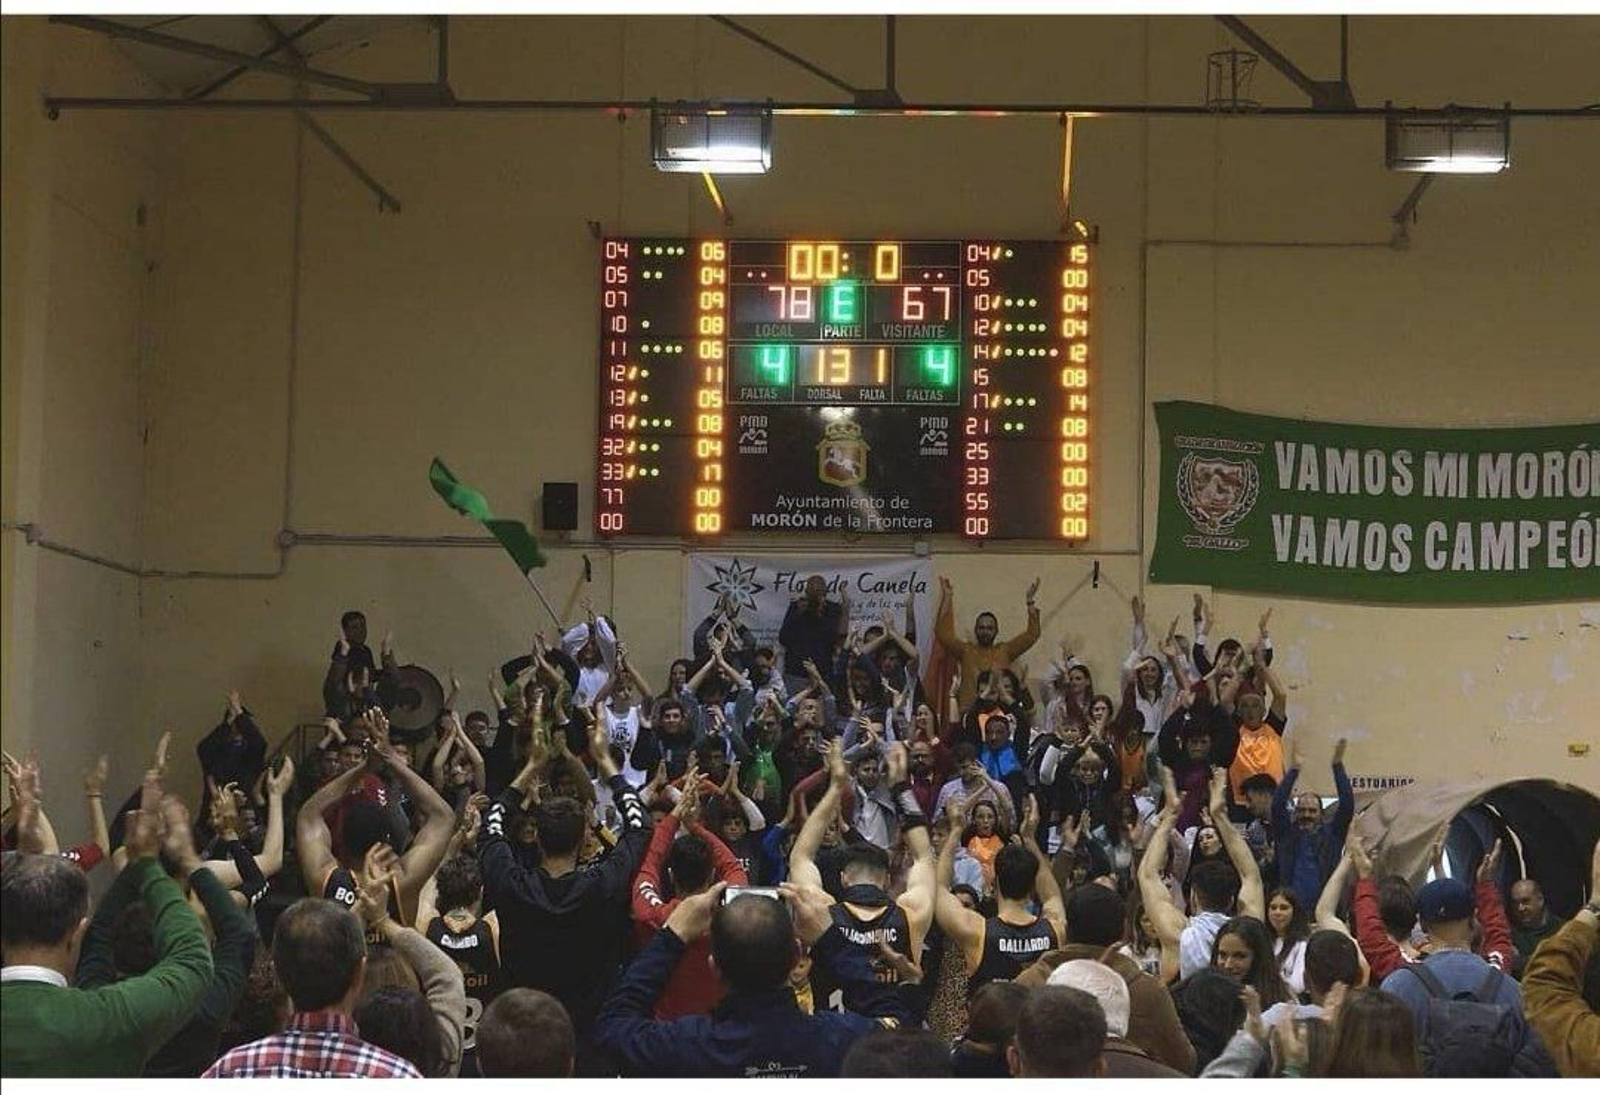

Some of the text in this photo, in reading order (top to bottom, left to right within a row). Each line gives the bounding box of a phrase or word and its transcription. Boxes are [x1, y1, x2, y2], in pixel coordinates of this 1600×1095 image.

[606, 242, 628, 259] 04
[876, 245, 898, 280] 0
[967, 245, 990, 262] 04
[606, 267, 627, 284] 05
[701, 267, 724, 284] 04
[967, 269, 990, 287] 05
[605, 291, 627, 308] 07
[700, 291, 724, 309] 09
[768, 287, 811, 320] 78
[832, 286, 853, 320] E
[903, 287, 950, 320] 67
[975, 294, 990, 311] 10
[612, 316, 627, 333] 10
[700, 316, 723, 334] 08
[755, 325, 794, 337] LOCAL
[824, 325, 861, 337] PARTE
[882, 325, 945, 337] VISITANTE
[974, 319, 989, 335] 12
[611, 341, 626, 356] 11
[974, 345, 989, 359] 14
[610, 365, 625, 382] 12
[763, 347, 785, 383] 4
[818, 349, 850, 383] 13
[926, 348, 949, 384] 4
[706, 366, 723, 382] 11
[974, 369, 989, 386] 15
[610, 390, 625, 406] 13
[699, 390, 722, 407] 05
[741, 388, 777, 399] FALTAS
[808, 389, 841, 399] DORSAL
[860, 389, 885, 400] FALTA
[907, 390, 943, 400] FALTAS
[974, 394, 988, 409] 17
[610, 415, 624, 430] 19
[698, 414, 722, 432] 08
[966, 417, 988, 434] 21
[603, 439, 624, 456] 32
[698, 439, 722, 457] 04
[966, 443, 988, 460] 25
[603, 464, 623, 480] 33
[704, 464, 722, 480] 17
[966, 467, 989, 485] 33
[1274, 441, 1413, 496] VAMOS
[1424, 451, 1468, 498] MI
[602, 489, 623, 505] 77
[697, 488, 721, 507] 00
[776, 495, 910, 511] Ayuntamiento de
[966, 492, 988, 510] 55
[601, 513, 623, 531] 00
[696, 513, 721, 531] 00
[751, 510, 933, 528] MORÓN de la Frontera
[966, 517, 988, 535] 00
[1272, 511, 1600, 573] VAMOS CAMPEÓ
[773, 571, 806, 593] Flo
[858, 571, 926, 594] Canela
[335, 886, 355, 904] BO
